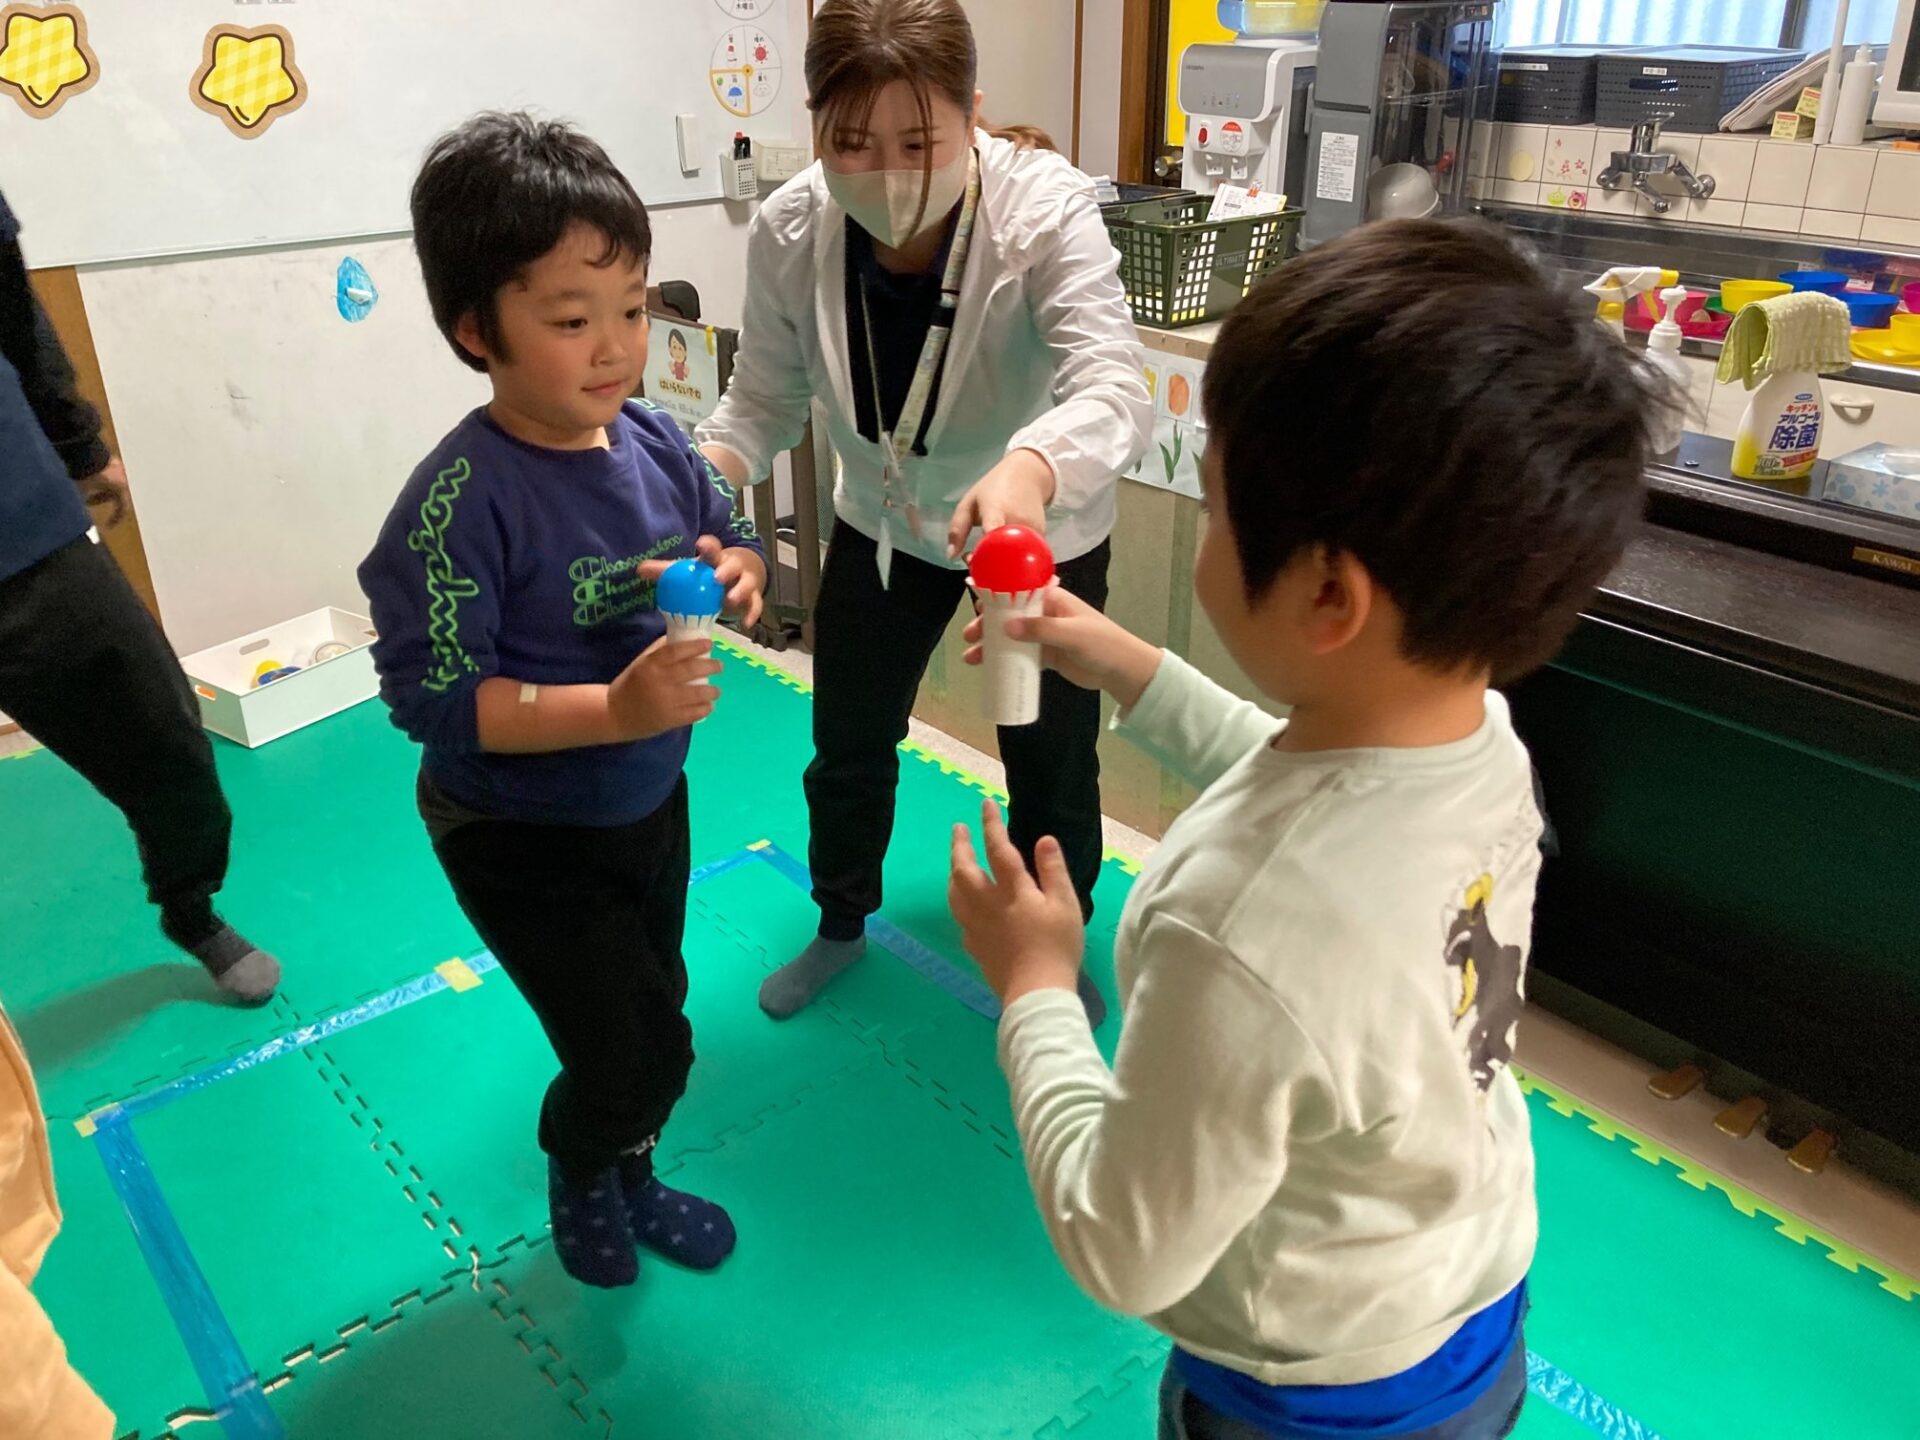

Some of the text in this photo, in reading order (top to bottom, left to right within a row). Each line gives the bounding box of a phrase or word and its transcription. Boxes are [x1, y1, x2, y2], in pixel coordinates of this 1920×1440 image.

[1778, 412, 1821, 424] アルコール
[1769, 423, 1818, 449] 除菌
[1872, 554, 1912, 571] KAWAI
